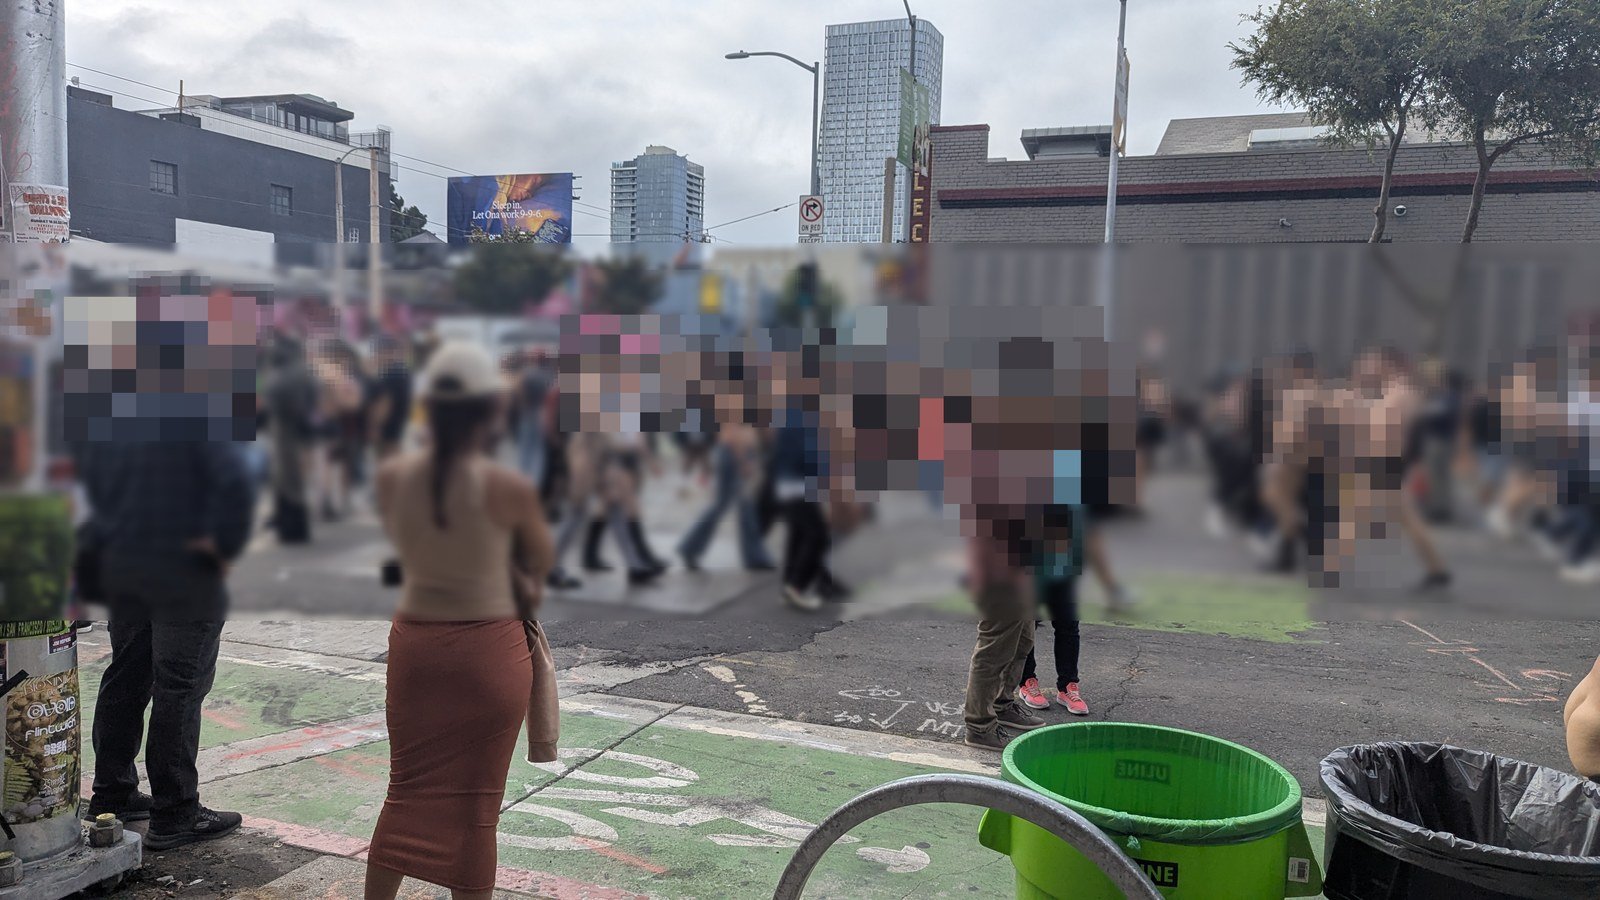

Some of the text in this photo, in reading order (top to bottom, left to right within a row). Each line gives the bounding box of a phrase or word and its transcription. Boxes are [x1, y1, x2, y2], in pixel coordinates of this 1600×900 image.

[492, 200, 522, 211] Sleep in.
[473, 209, 543, 220] Let Ona work 9-9-6.
